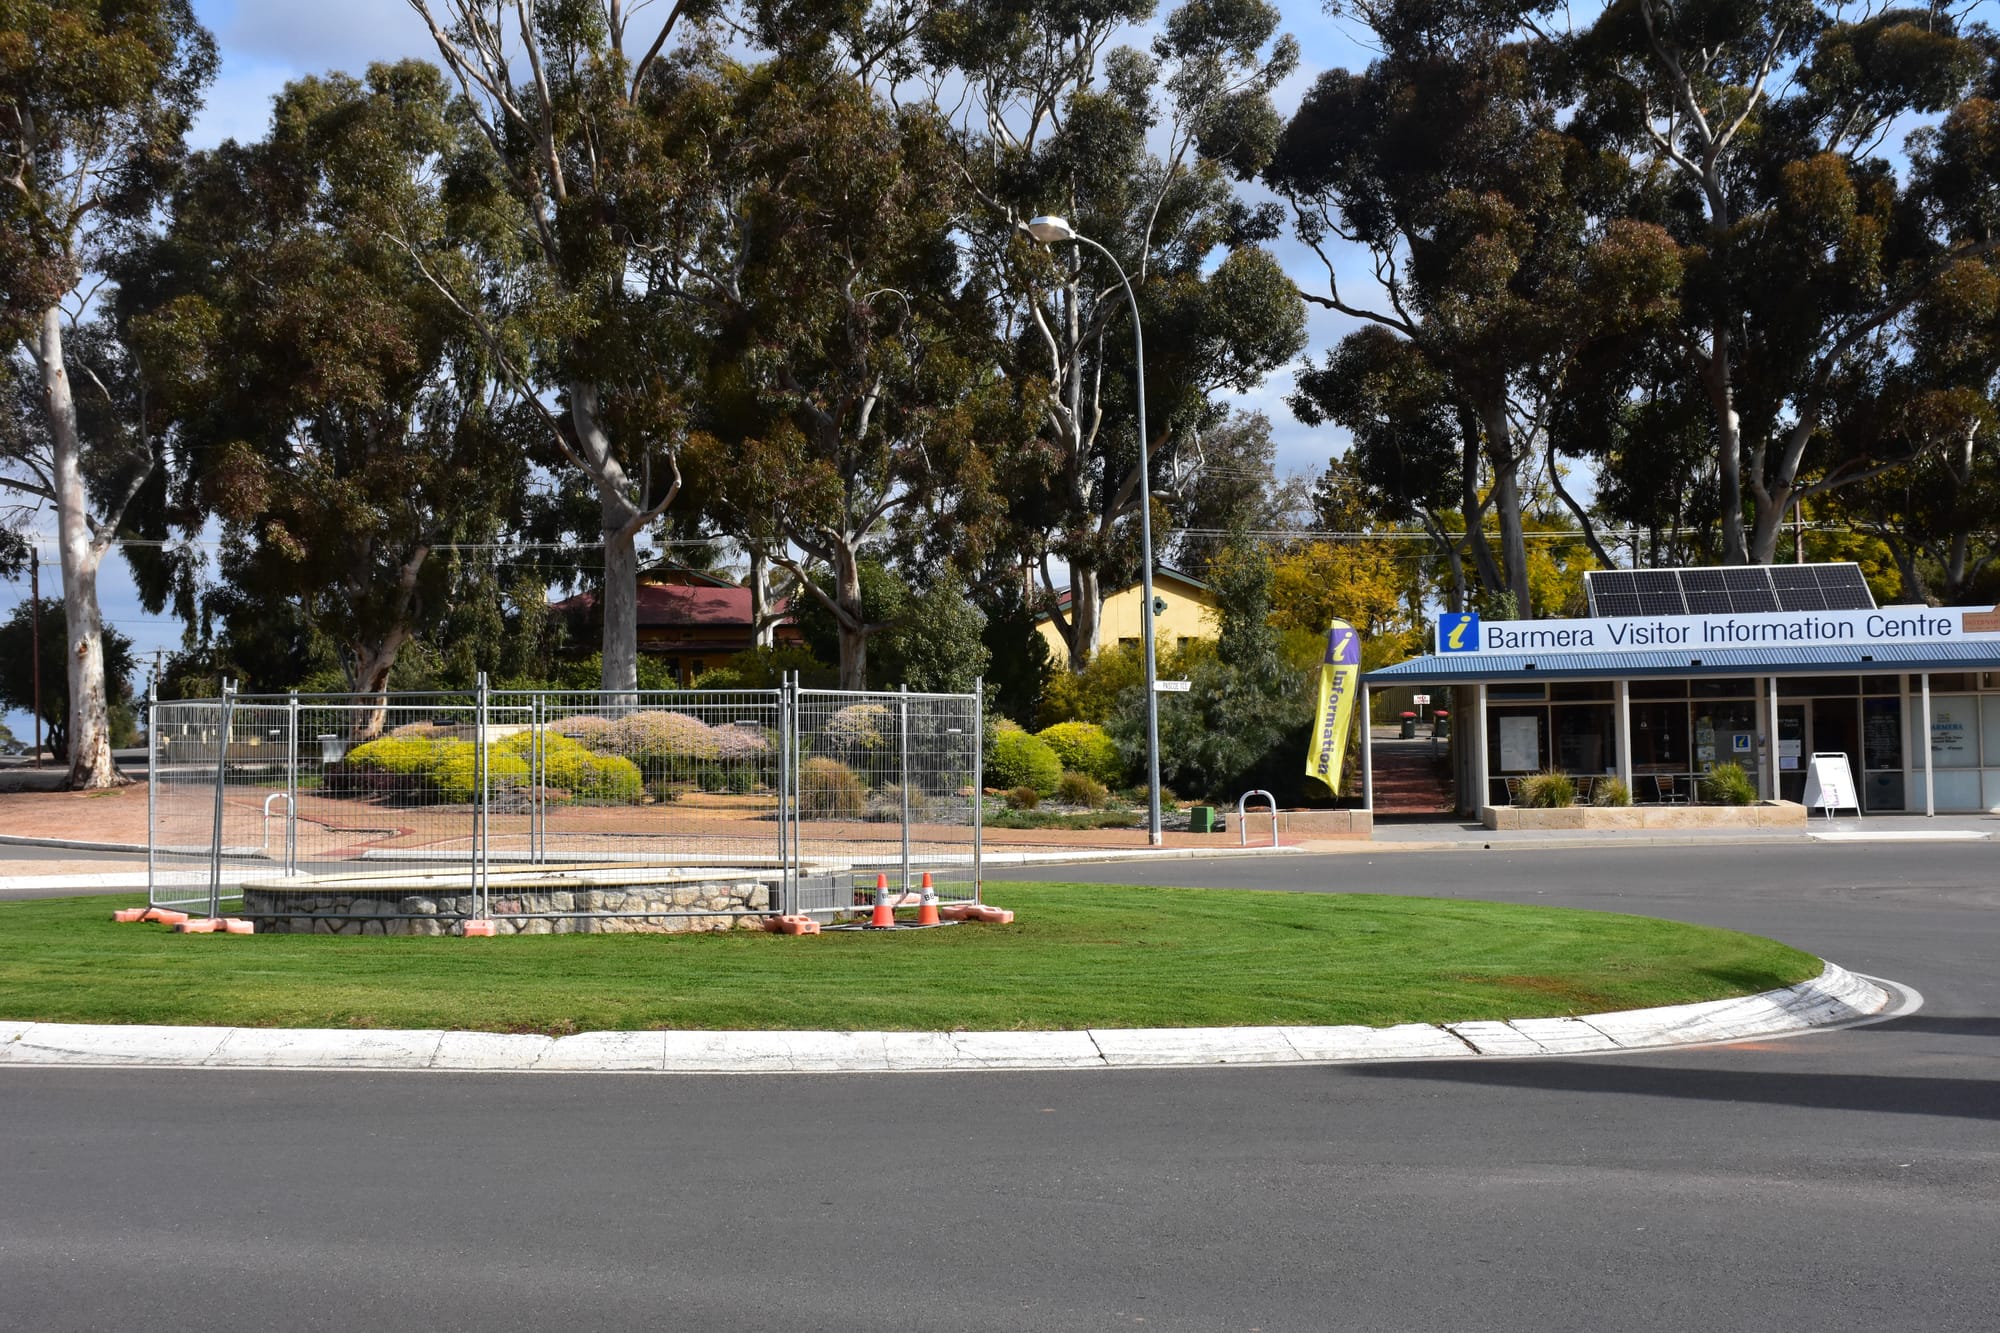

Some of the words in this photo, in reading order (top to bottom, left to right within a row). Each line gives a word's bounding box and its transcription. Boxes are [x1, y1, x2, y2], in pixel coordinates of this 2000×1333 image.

[1488, 627, 1595, 649] Barmera
[1606, 622, 1690, 645] Visitor
[1703, 617, 1854, 643] Information
[1866, 614, 1952, 638] Centre
[1317, 670, 1348, 776] Information
